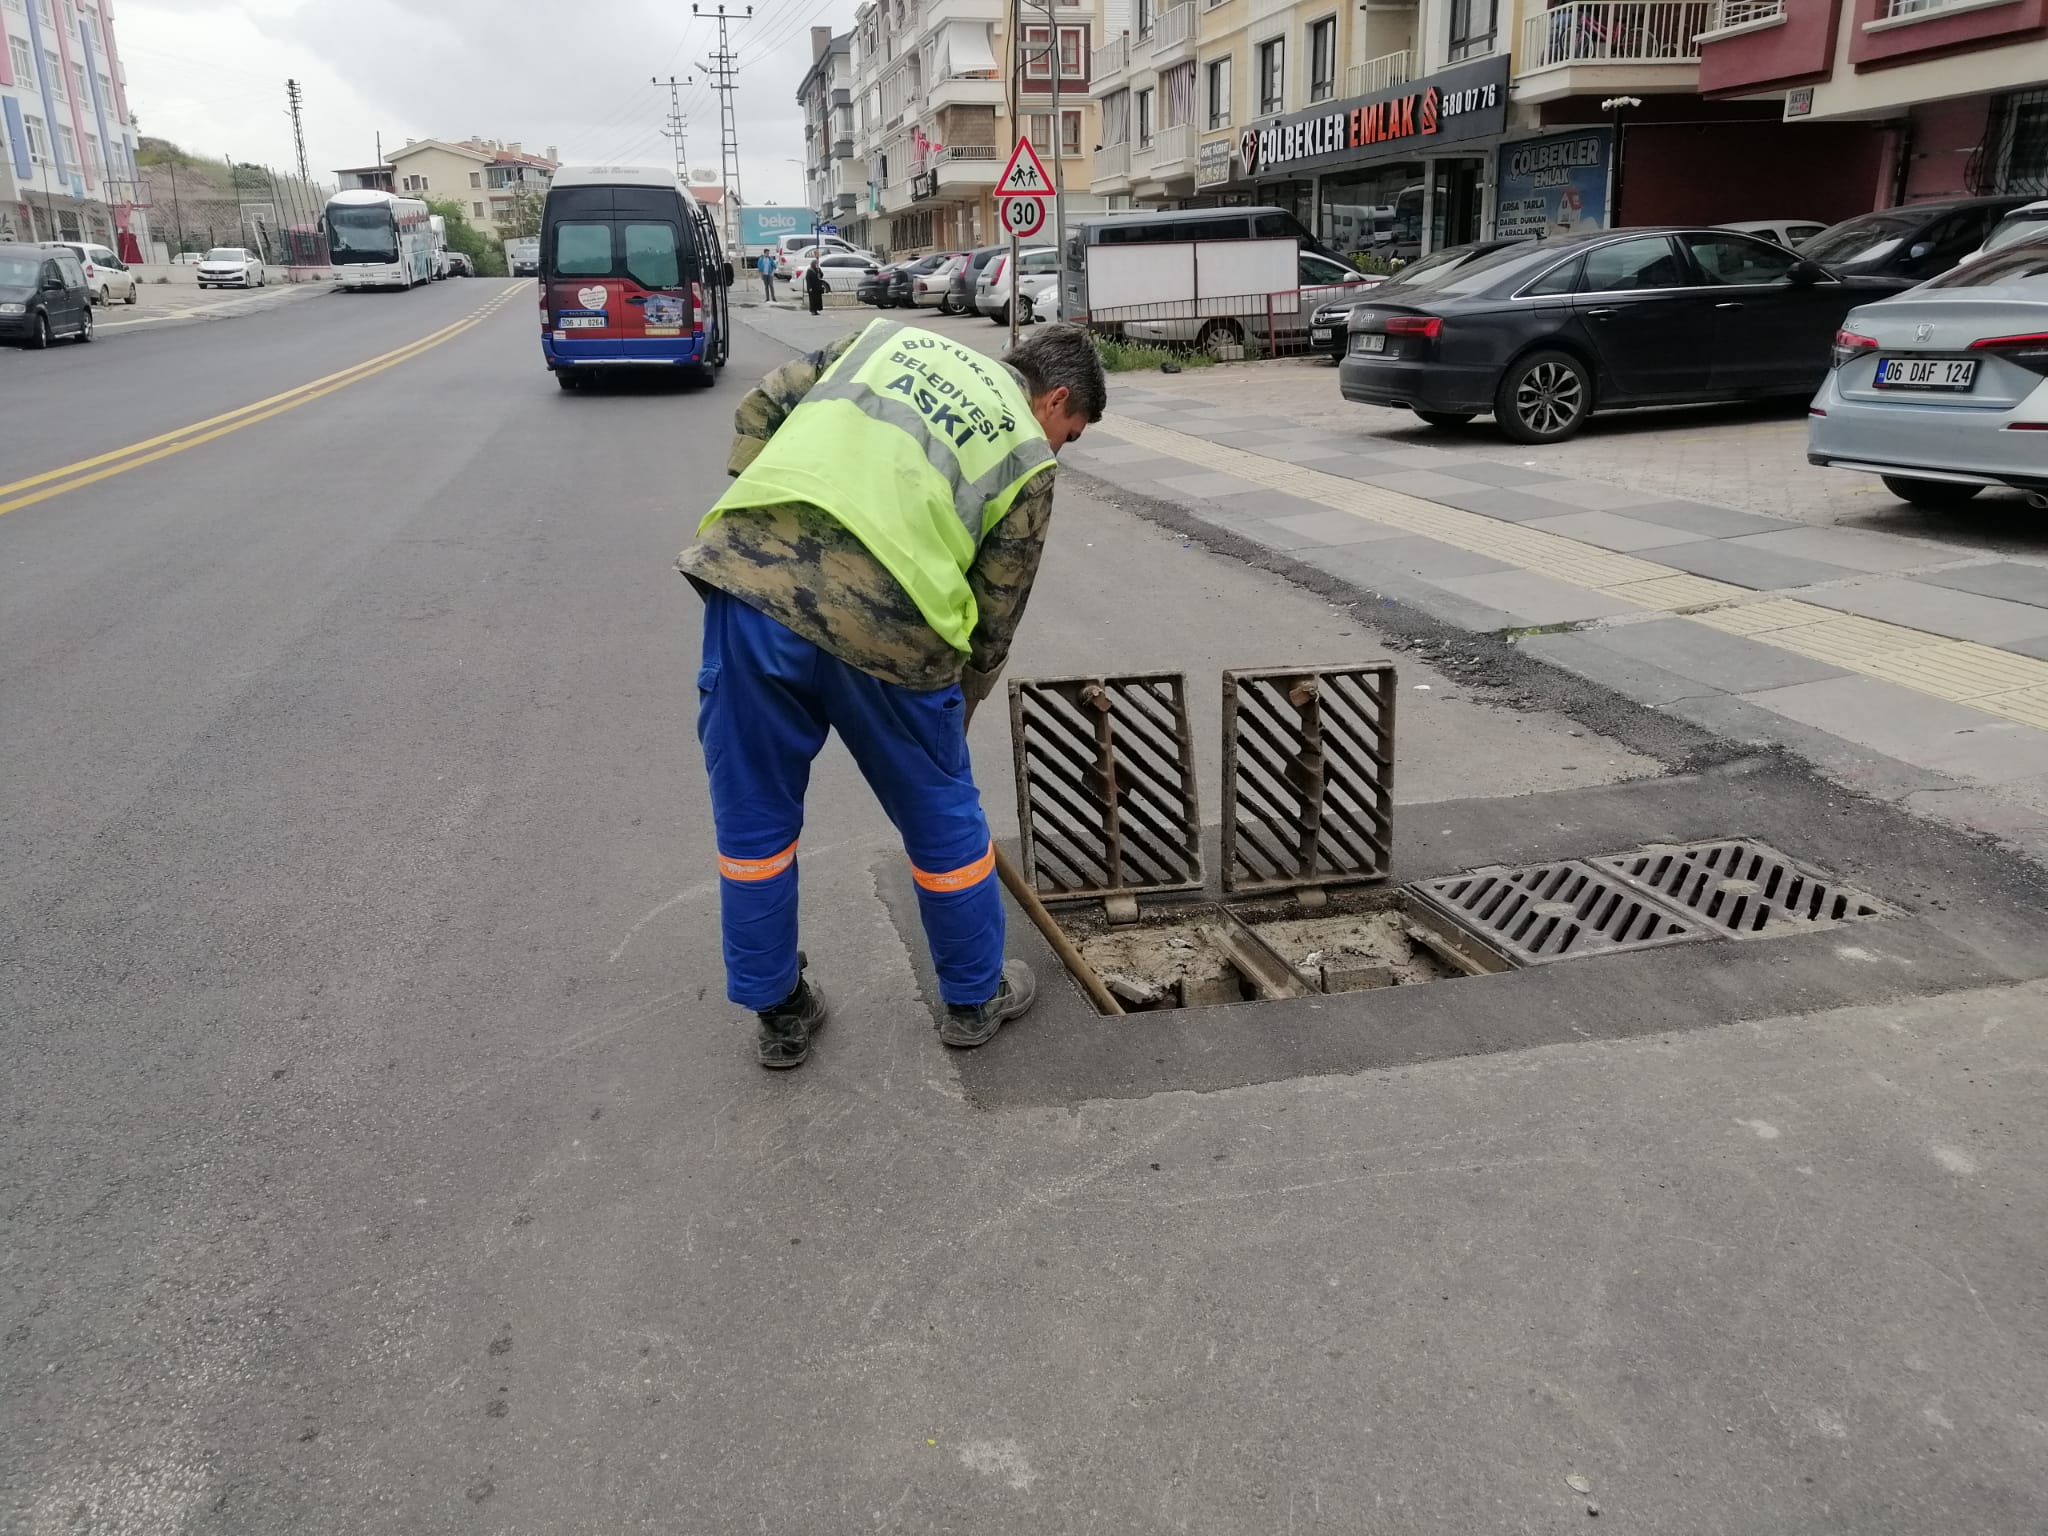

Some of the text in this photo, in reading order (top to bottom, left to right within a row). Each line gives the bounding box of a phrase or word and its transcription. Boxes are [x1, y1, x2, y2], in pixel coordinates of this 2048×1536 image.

[1349, 94, 1417, 148] EMLAK
[1442, 91, 1463, 117] 580
[1465, 88, 1479, 111] 07
[1481, 83, 1496, 108] 76
[1510, 137, 1600, 181] ÇÖLBEKLER
[1533, 167, 1570, 188] EMLAK
[1013, 202, 1034, 225] 30
[1502, 199, 1545, 212] ARSA TARLA
[759, 214, 796, 227] beko
[1886, 362, 1903, 381] 06
[1909, 362, 1938, 383] DAF
[1945, 362, 1972, 384] 124
